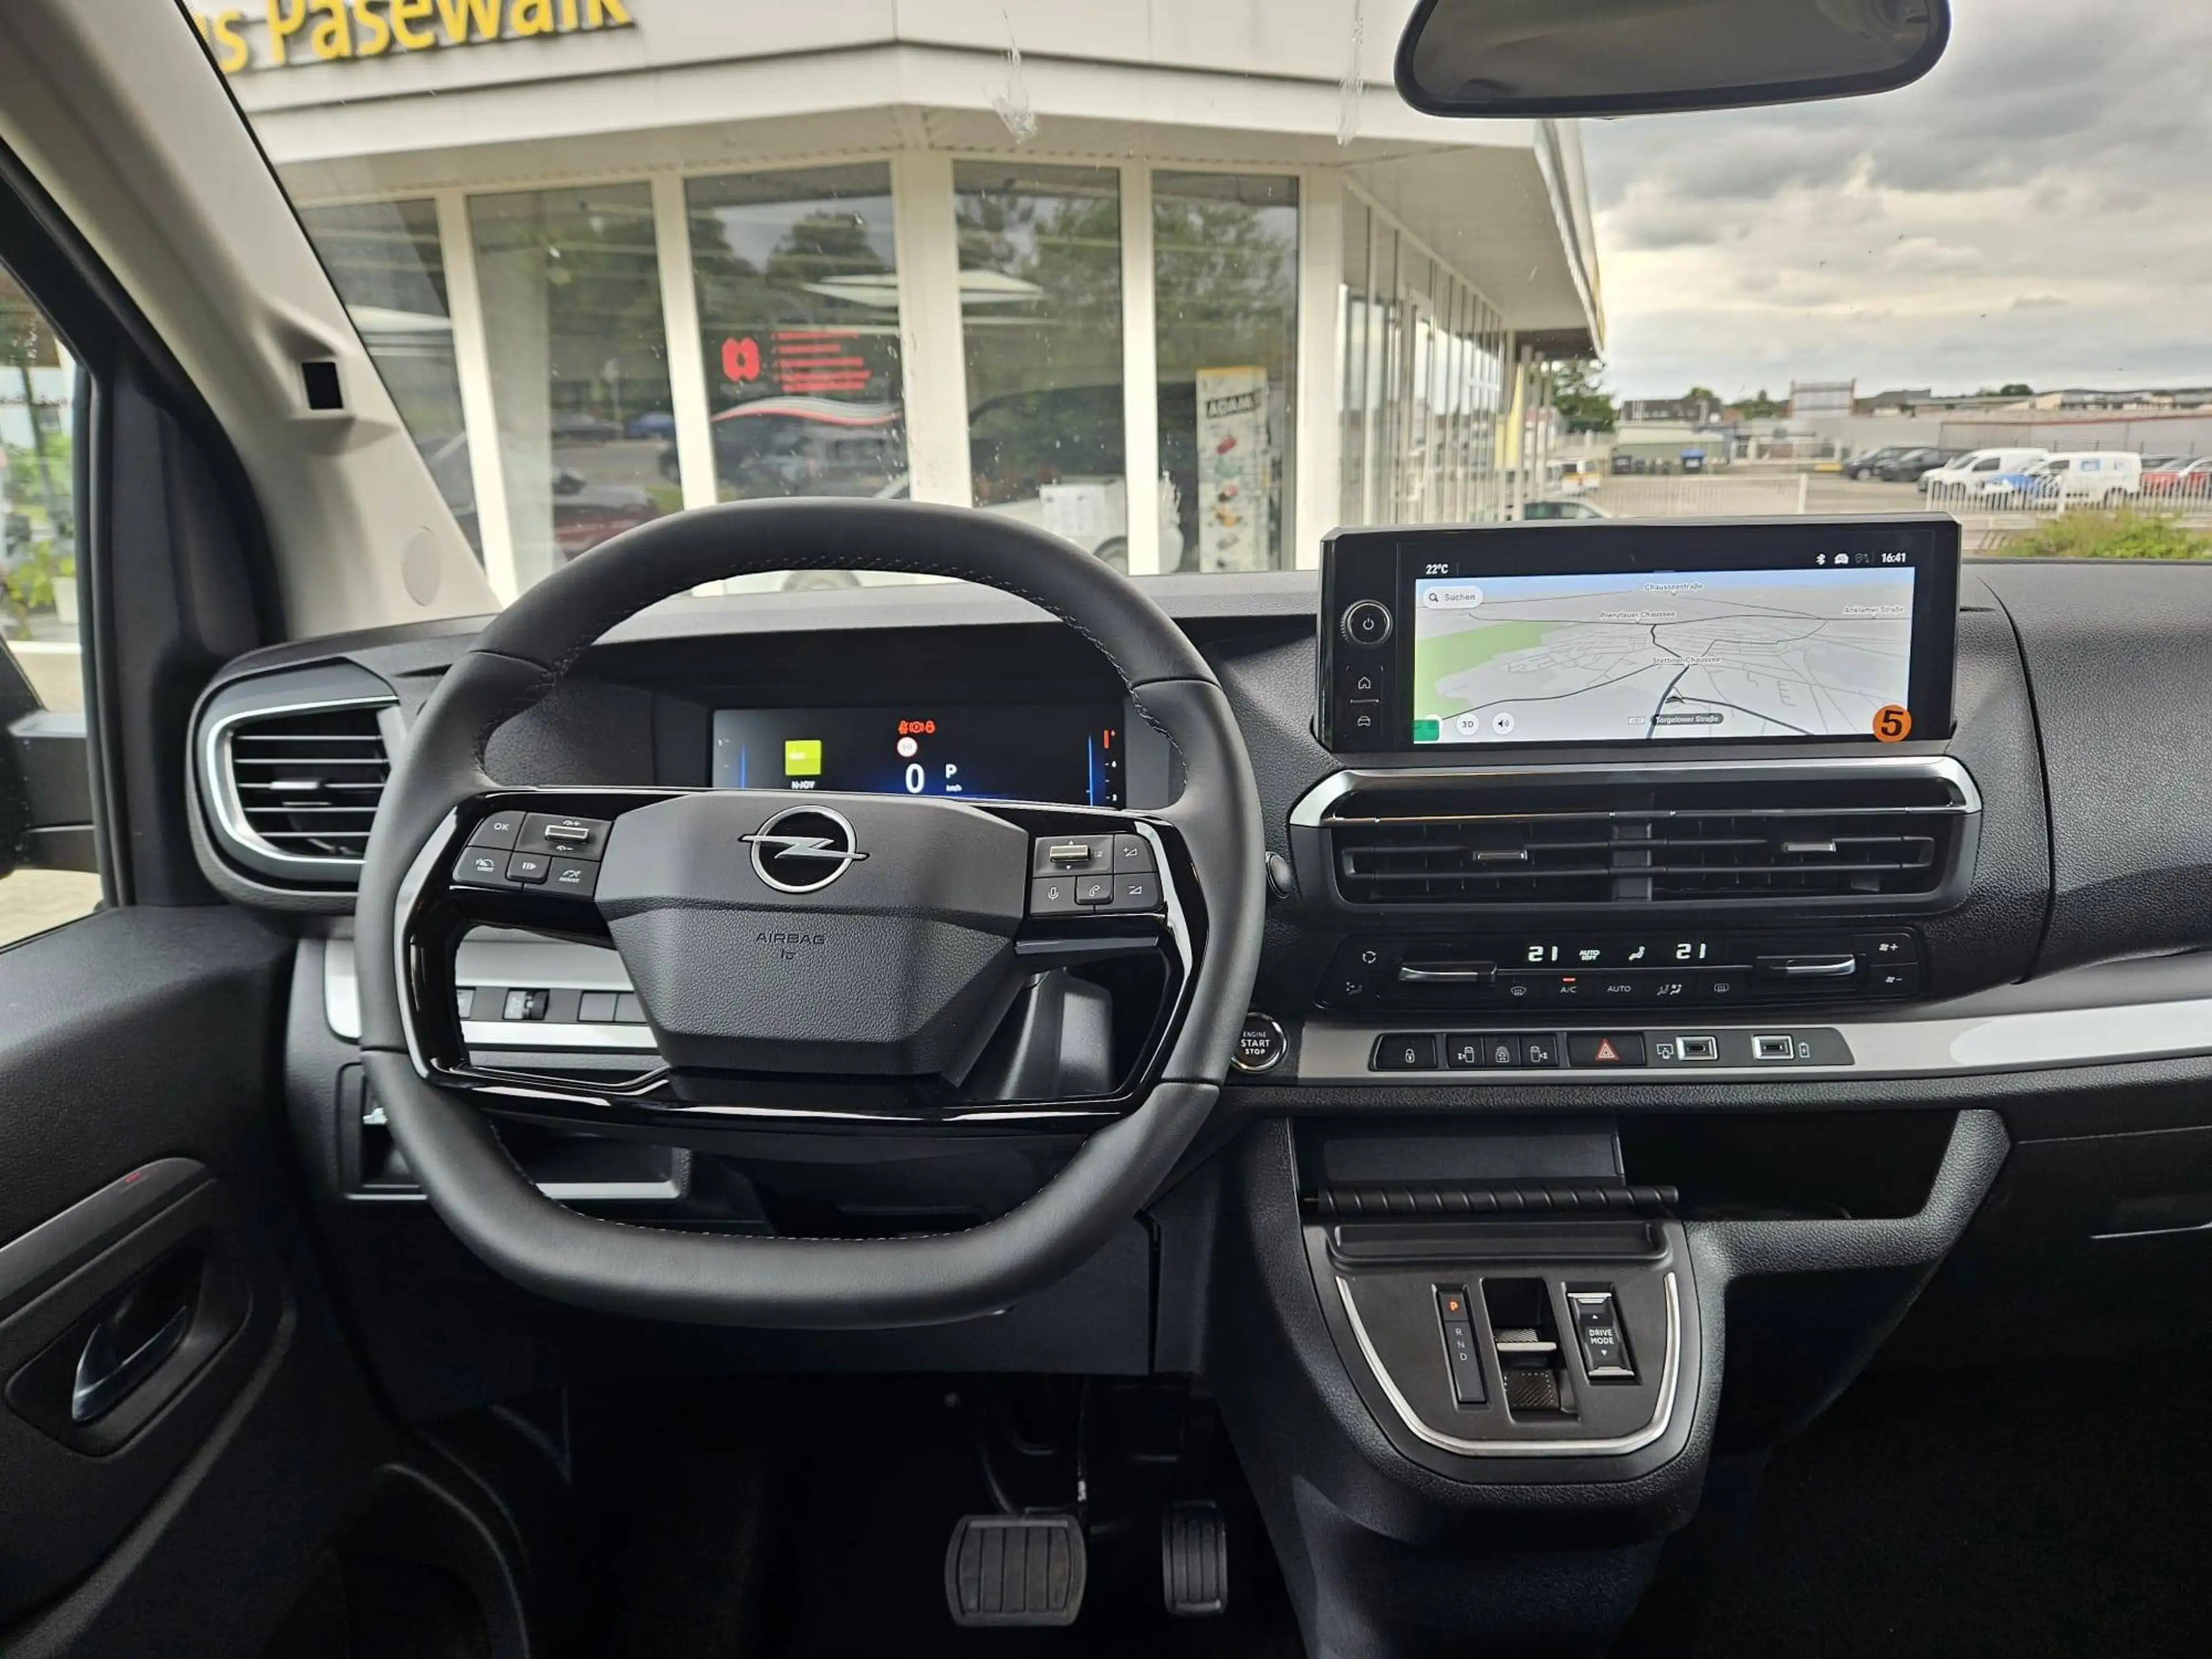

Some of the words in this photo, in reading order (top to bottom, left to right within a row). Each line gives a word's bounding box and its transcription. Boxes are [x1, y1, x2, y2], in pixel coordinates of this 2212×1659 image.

[195, 8, 248, 73] s
[1881, 552, 1907, 563] 16:41
[1444, 593, 1475, 601] Suchen
[1881, 710, 1903, 736] 5
[906, 763, 925, 793] 0
[945, 763, 957, 778] P
[494, 822, 510, 831] OK
[756, 933, 826, 945] AIRBAG
[1528, 946, 1558, 962] 21
[1676, 943, 1707, 959] 21
[1241, 1039, 1271, 1047] START
[1449, 1301, 1459, 1310] P
[1455, 1327, 1463, 1336] R
[1460, 1352, 1468, 1361] D
